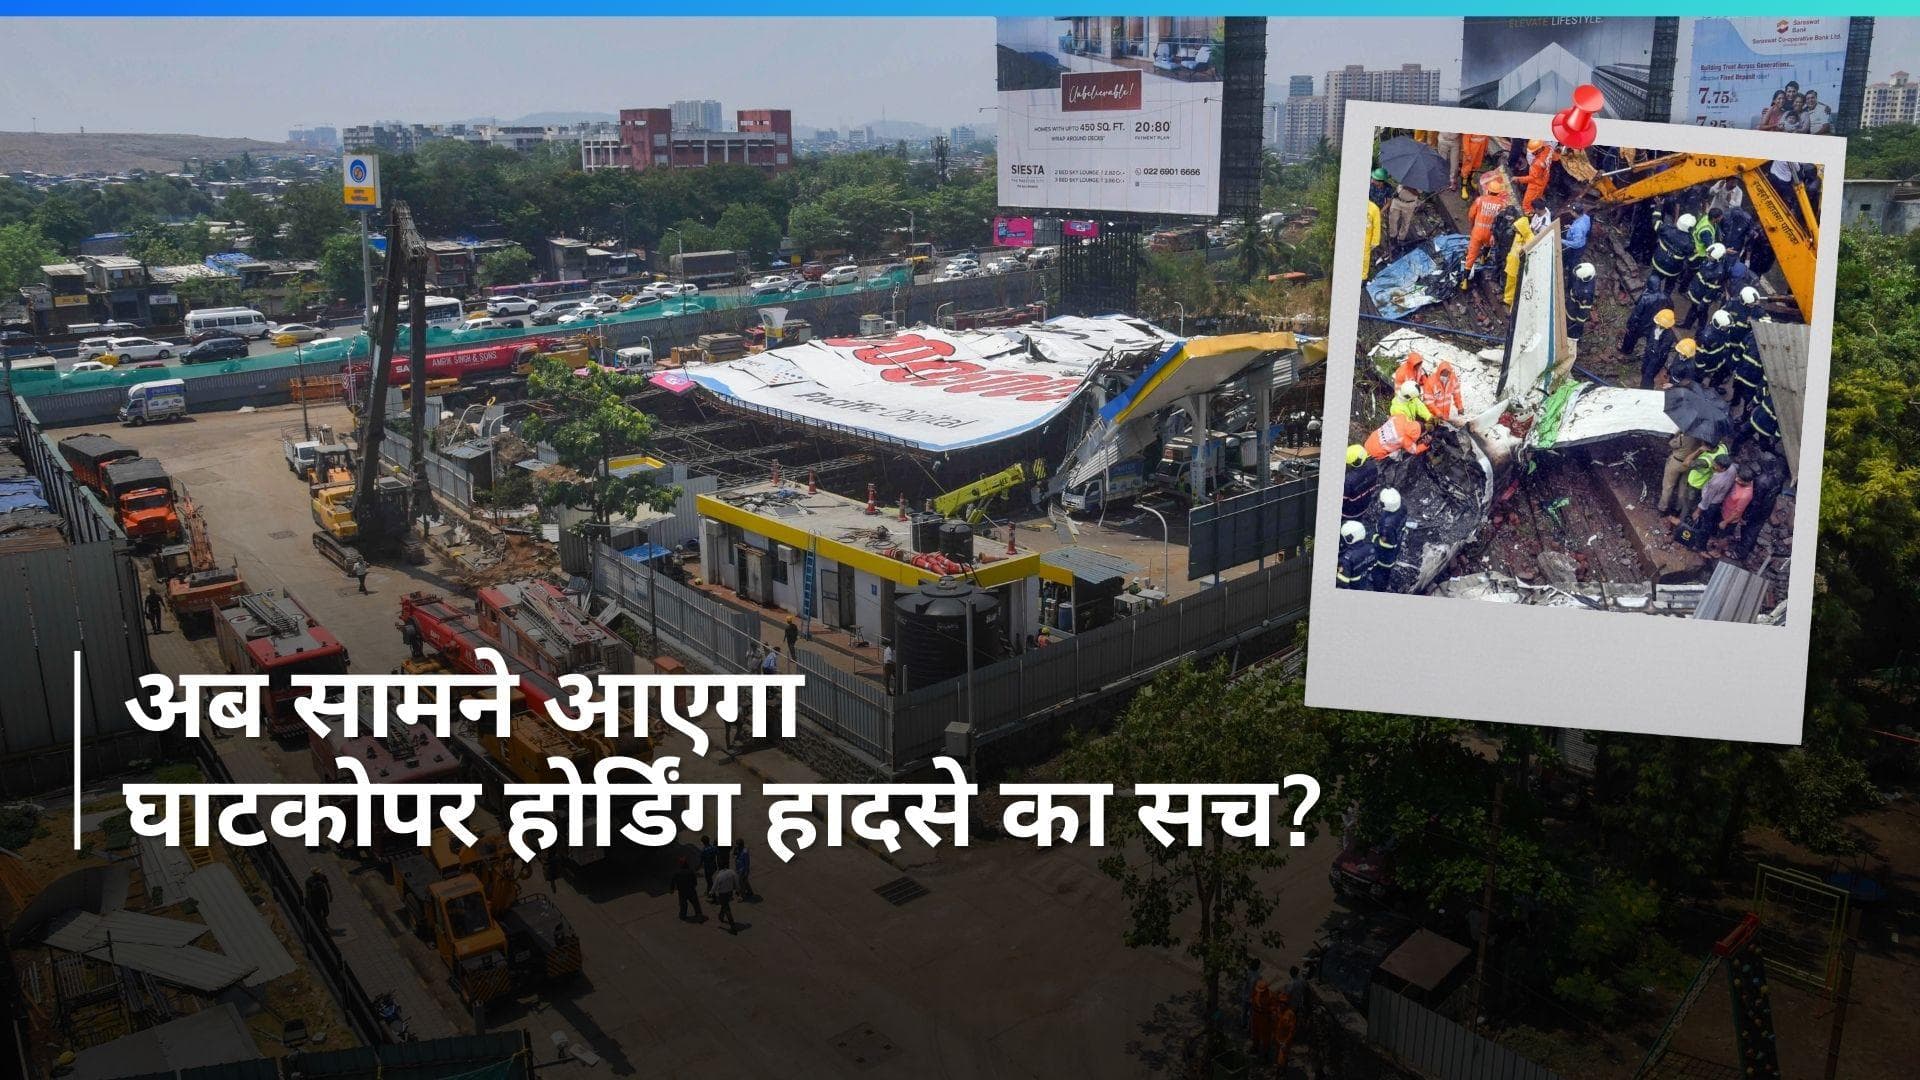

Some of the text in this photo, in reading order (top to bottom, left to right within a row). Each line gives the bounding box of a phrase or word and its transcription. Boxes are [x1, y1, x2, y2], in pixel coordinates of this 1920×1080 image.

[1778, 35, 1814, 43] Co-operative
[1069, 83, 1134, 103] Unbelievable!
[1080, 123, 1095, 131] 450
[1113, 122, 1125, 131] FT.
[1695, 158, 1716, 167] JCB
[1011, 165, 1045, 175] SIESTA
[454, 356, 471, 364] SINGH
[479, 351, 497, 361] SONS
[794, 392, 979, 429] Pacific Digital
